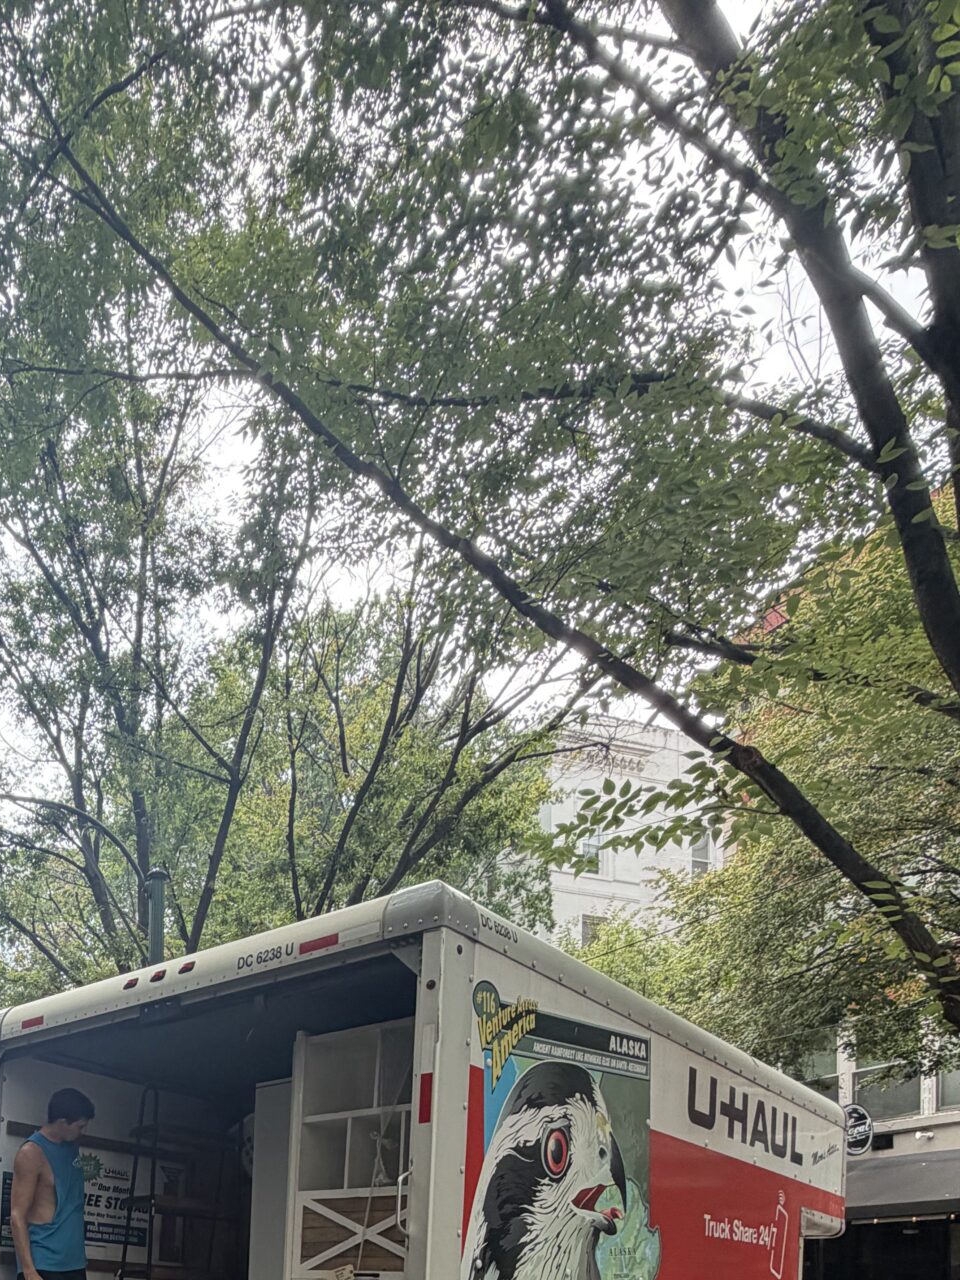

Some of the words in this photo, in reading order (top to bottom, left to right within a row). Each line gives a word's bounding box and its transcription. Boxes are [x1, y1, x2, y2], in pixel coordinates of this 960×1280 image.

[511, 929, 518, 943] U
[237, 954, 253, 970] DC
[256, 946, 282, 965] 6238
[285, 942, 294, 956] U
[476, 991, 496, 1014] #116
[477, 1003, 516, 1050] Venture
[492, 1012, 537, 1090] America
[609, 1035, 647, 1058] ALASKA
[688, 1066, 803, 1167] U-HAUL
[98, 1183, 111, 1192] One
[704, 1214, 731, 1238] Truck
[732, 1219, 758, 1244] Share
[759, 1223, 778, 1250] 24/7
[609, 1247, 638, 1257] ALASKA
